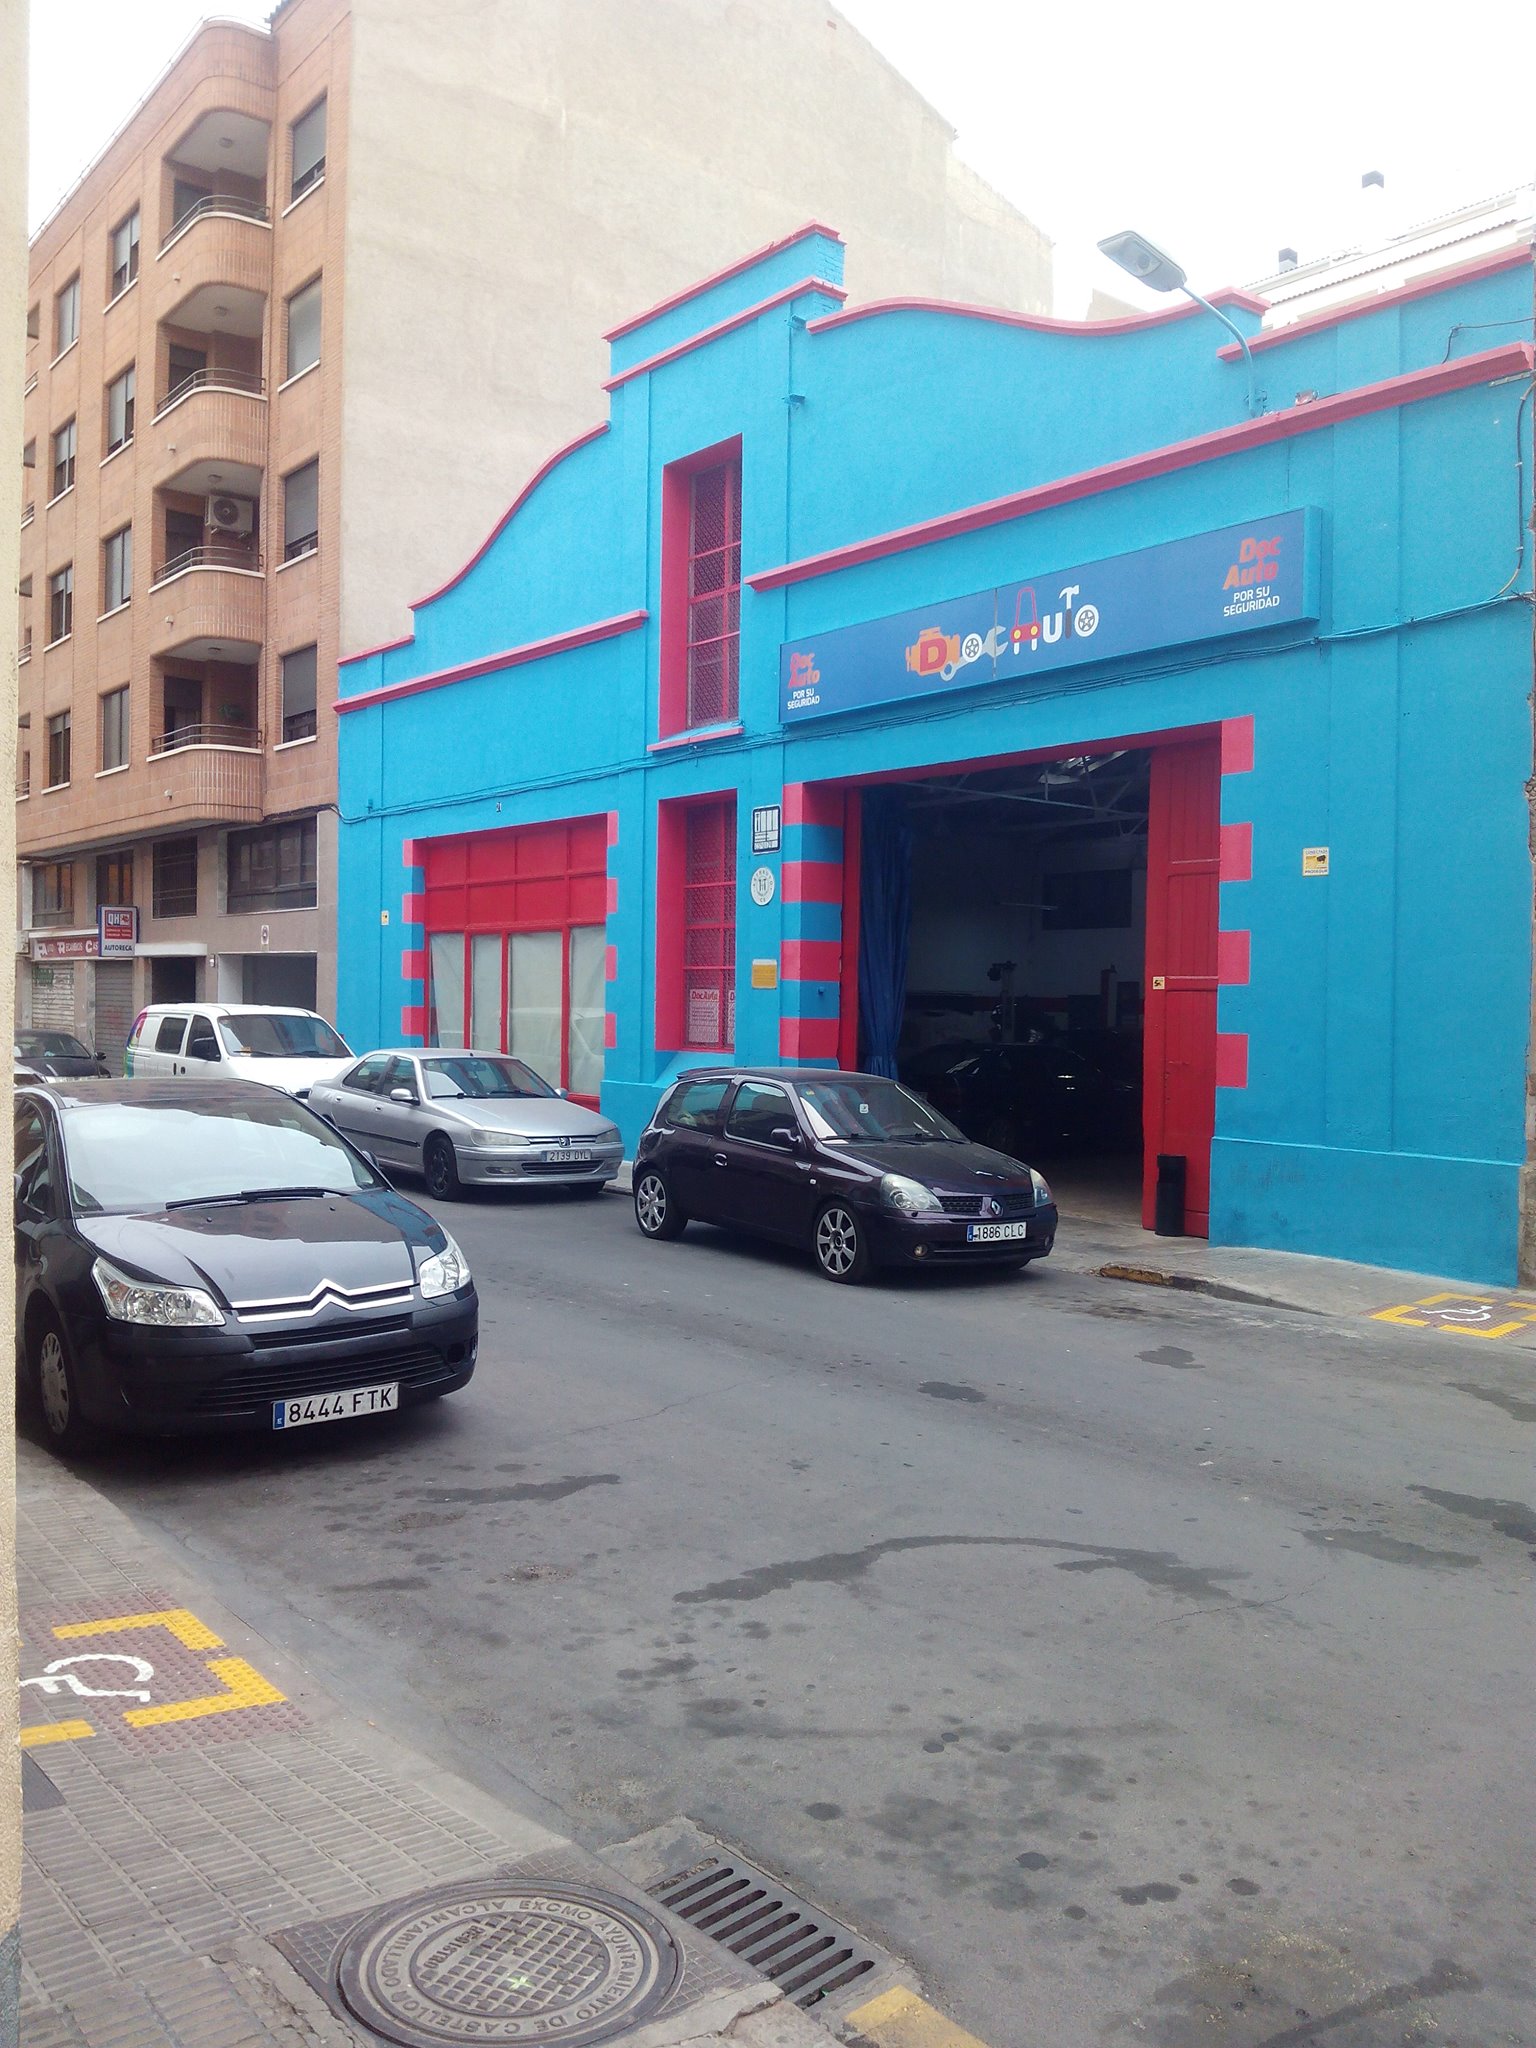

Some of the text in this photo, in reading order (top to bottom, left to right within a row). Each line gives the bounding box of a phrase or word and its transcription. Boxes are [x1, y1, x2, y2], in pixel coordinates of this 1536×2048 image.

[1239, 536, 1282, 563] Doc
[1222, 559, 1279, 590] Auto
[1233, 585, 1270, 603] POR SU
[1223, 595, 1280, 617] SEGURIDAD
[787, 695, 820, 710] SEGURIDAD
[793, 688, 815, 699] POR SU
[978, 1224, 1024, 1239] 1886 CLC
[289, 1387, 392, 1423] 8444 FTK
[519, 1900, 592, 1921] EXCMO
[381, 1900, 506, 1988] ALCANTARILLADO
[576, 1920, 637, 2020] AYUNTAMIENTO
[534, 2015, 568, 2032] DE
